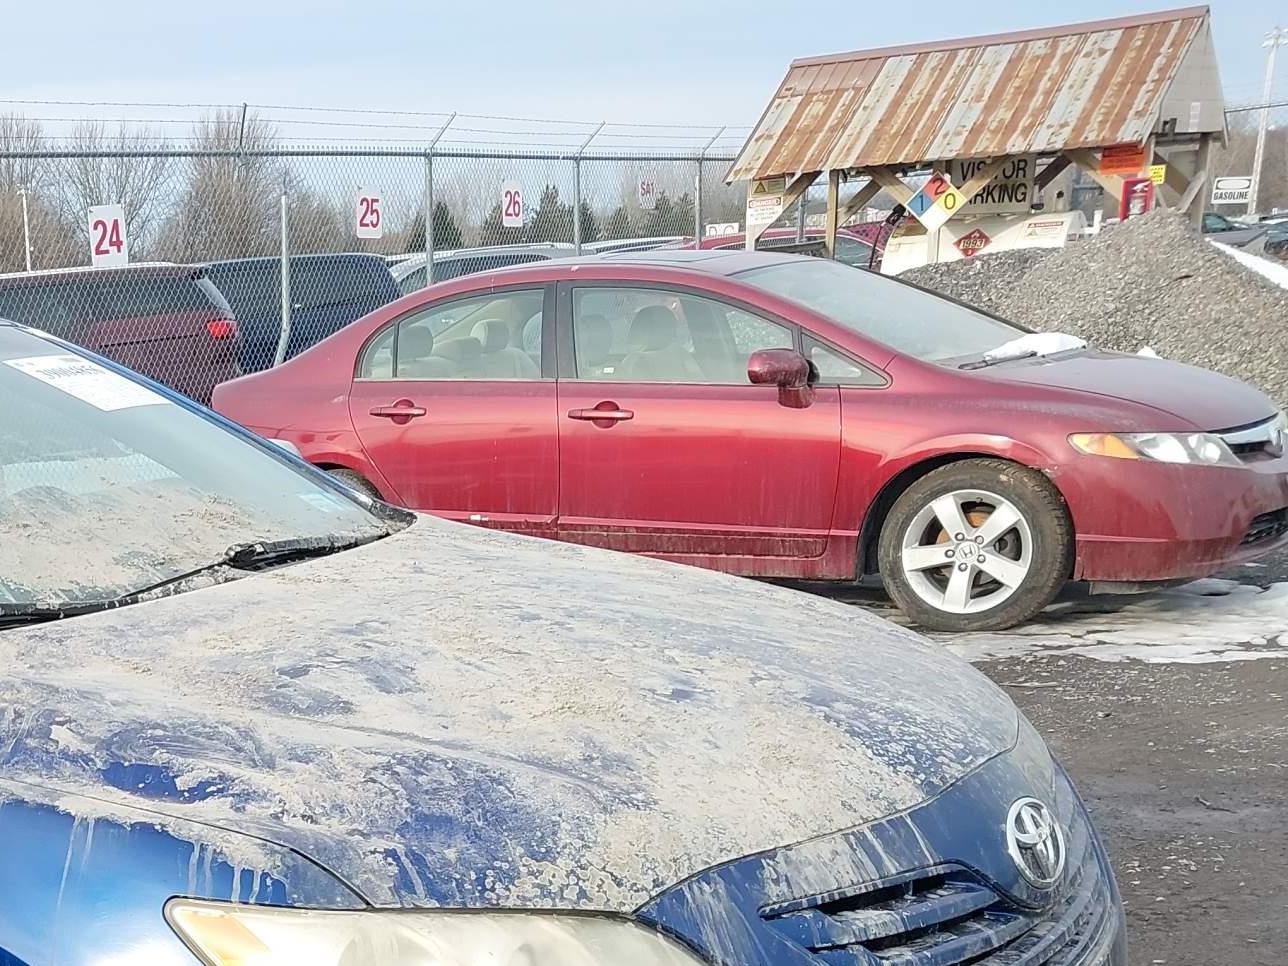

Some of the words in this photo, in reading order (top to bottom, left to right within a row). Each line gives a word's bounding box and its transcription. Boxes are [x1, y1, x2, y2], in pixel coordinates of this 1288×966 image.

[932, 178, 946, 196] 2
[964, 182, 1027, 204] RKING
[1214, 191, 1250, 200] GASOLINE
[359, 197, 380, 228] 25
[504, 190, 521, 217] 26
[919, 194, 925, 211] 1
[944, 193, 956, 209] 0
[93, 218, 123, 255] 24
